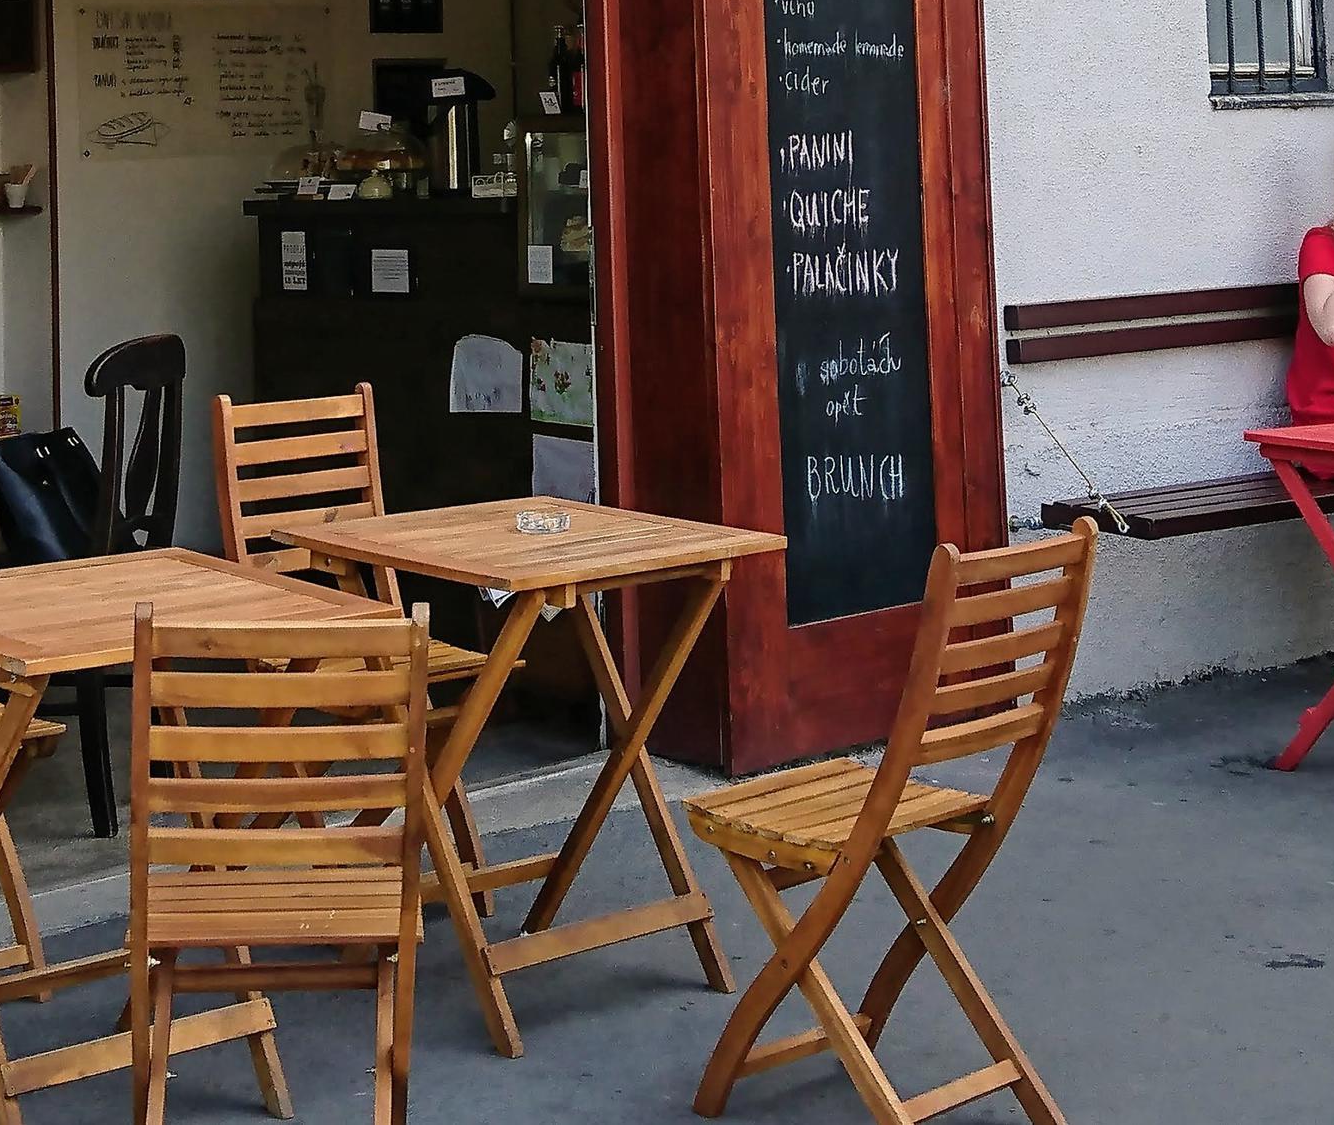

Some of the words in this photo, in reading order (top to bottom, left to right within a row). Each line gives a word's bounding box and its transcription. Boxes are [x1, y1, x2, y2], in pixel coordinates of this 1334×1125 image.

[784, 28, 847, 58] homemade
[788, 130, 854, 170] PANINI
[790, 189, 870, 231] QUICHE
[793, 243, 899, 297] PALAČINKY
[807, 453, 904, 503] BRUNCH
